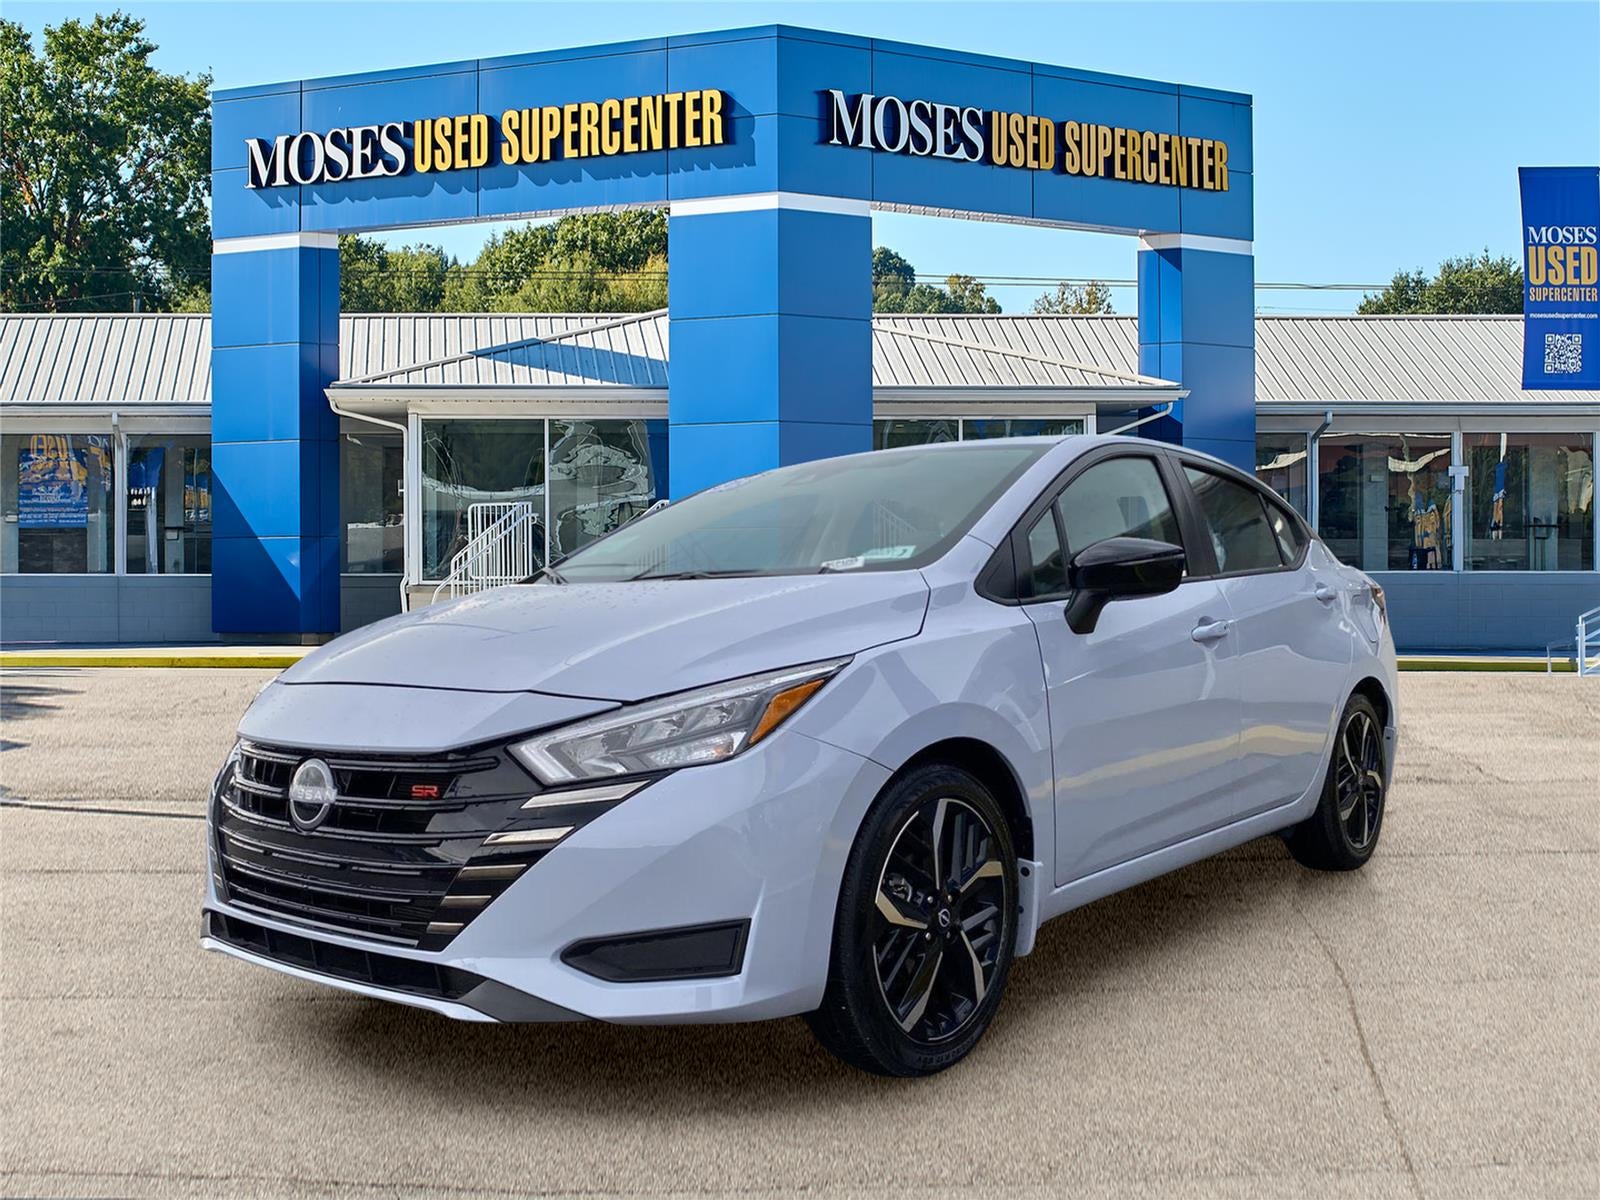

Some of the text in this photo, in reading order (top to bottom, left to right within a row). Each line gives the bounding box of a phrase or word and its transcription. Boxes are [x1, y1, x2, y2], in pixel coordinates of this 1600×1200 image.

[245, 89, 724, 190] MOSES USED SUPERCENTER
[829, 89, 1229, 192] MOSES USED SUPERCENTER
[1528, 226, 1597, 244] MOSES
[1528, 246, 1598, 286] USED
[1529, 287, 1598, 302] SUPERCENTER
[290, 786, 338, 802] SSAN
[411, 785, 439, 797] SR
